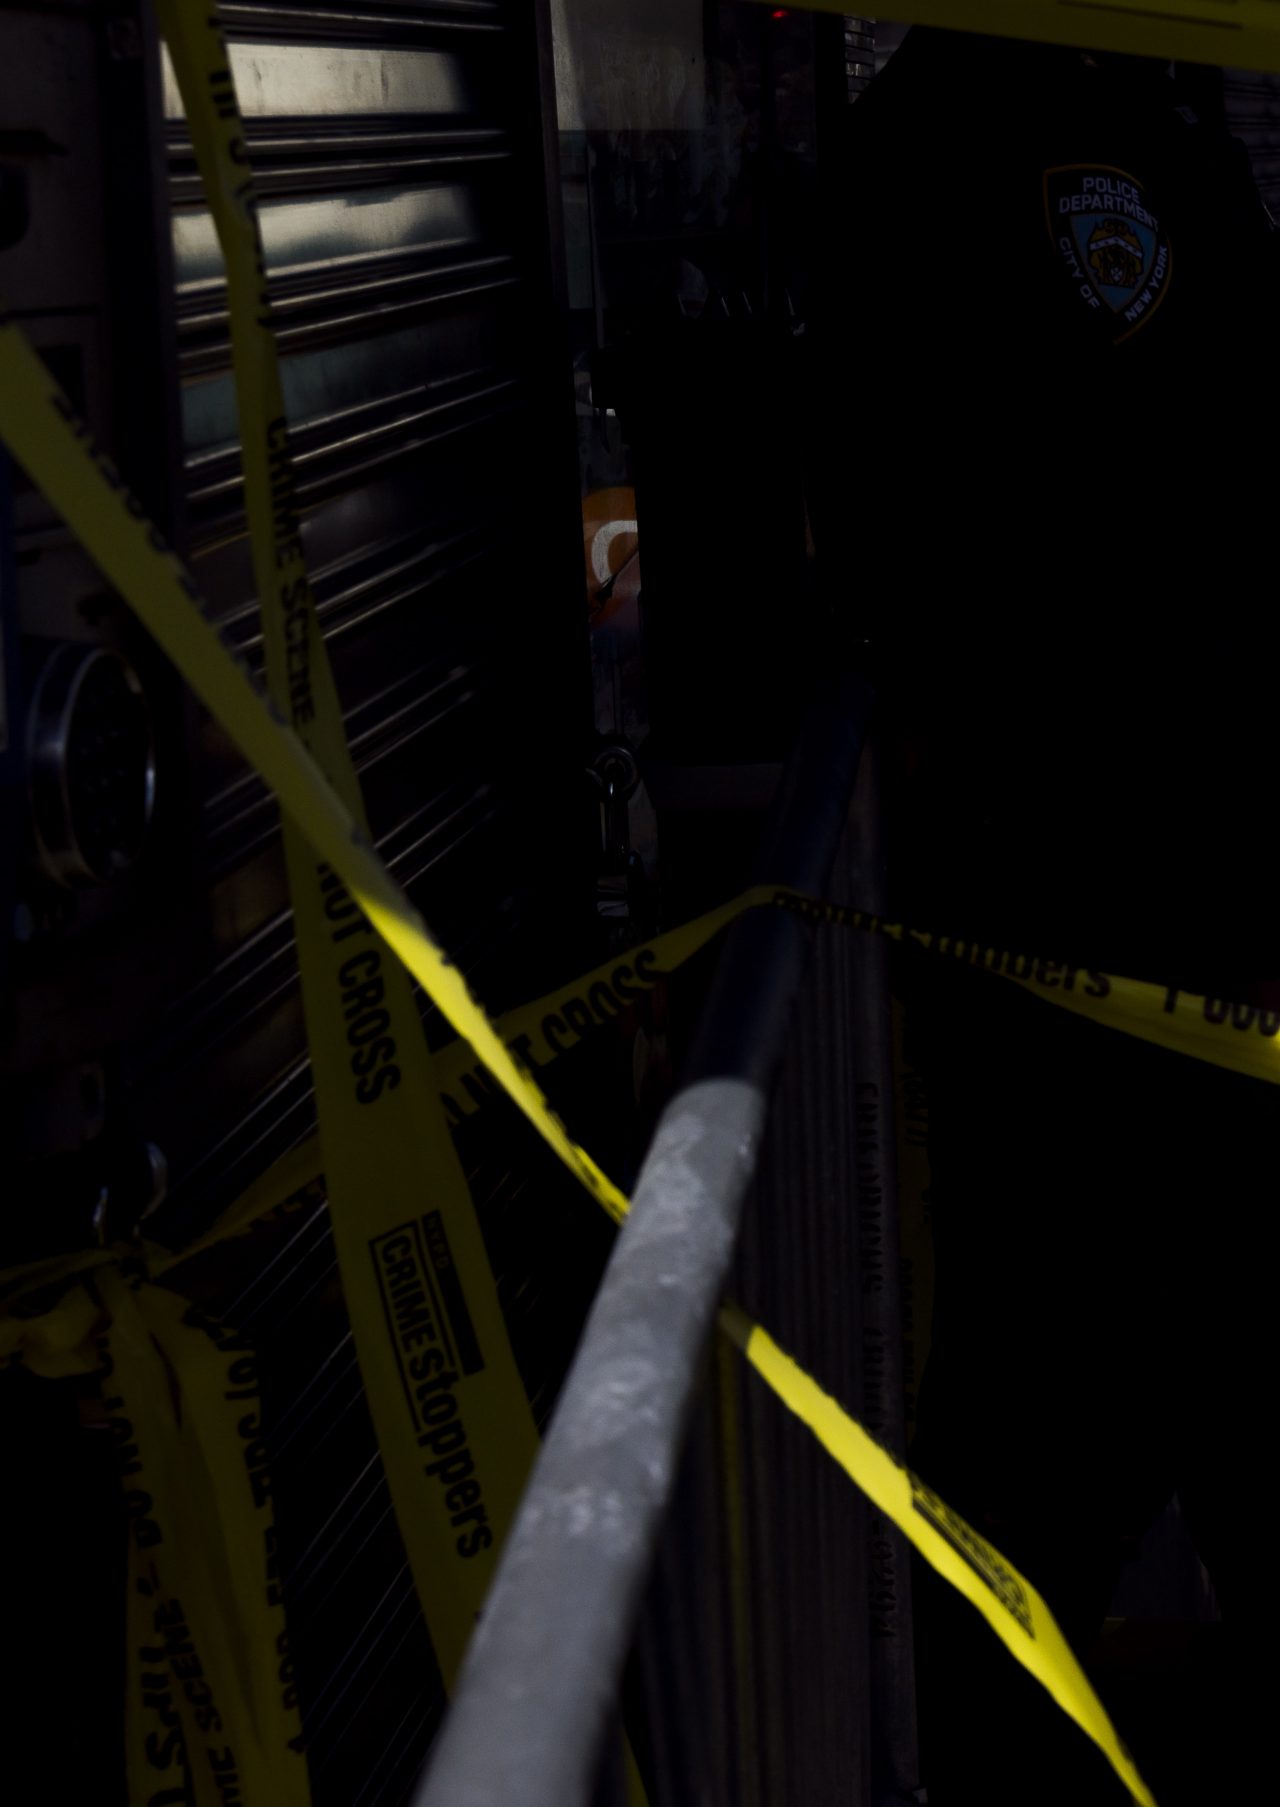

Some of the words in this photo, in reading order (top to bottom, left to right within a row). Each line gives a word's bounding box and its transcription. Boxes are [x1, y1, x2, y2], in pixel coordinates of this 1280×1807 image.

[1058, 194, 1160, 233] DEPARTMENT
[1082, 177, 1141, 204] POLICE
[1058, 236, 1086, 279] CITY
[1080, 284, 1101, 310] OF
[1124, 288, 1153, 322] NEW
[1149, 244, 1169, 289] YORK
[338, 949, 403, 1105] CROSS
